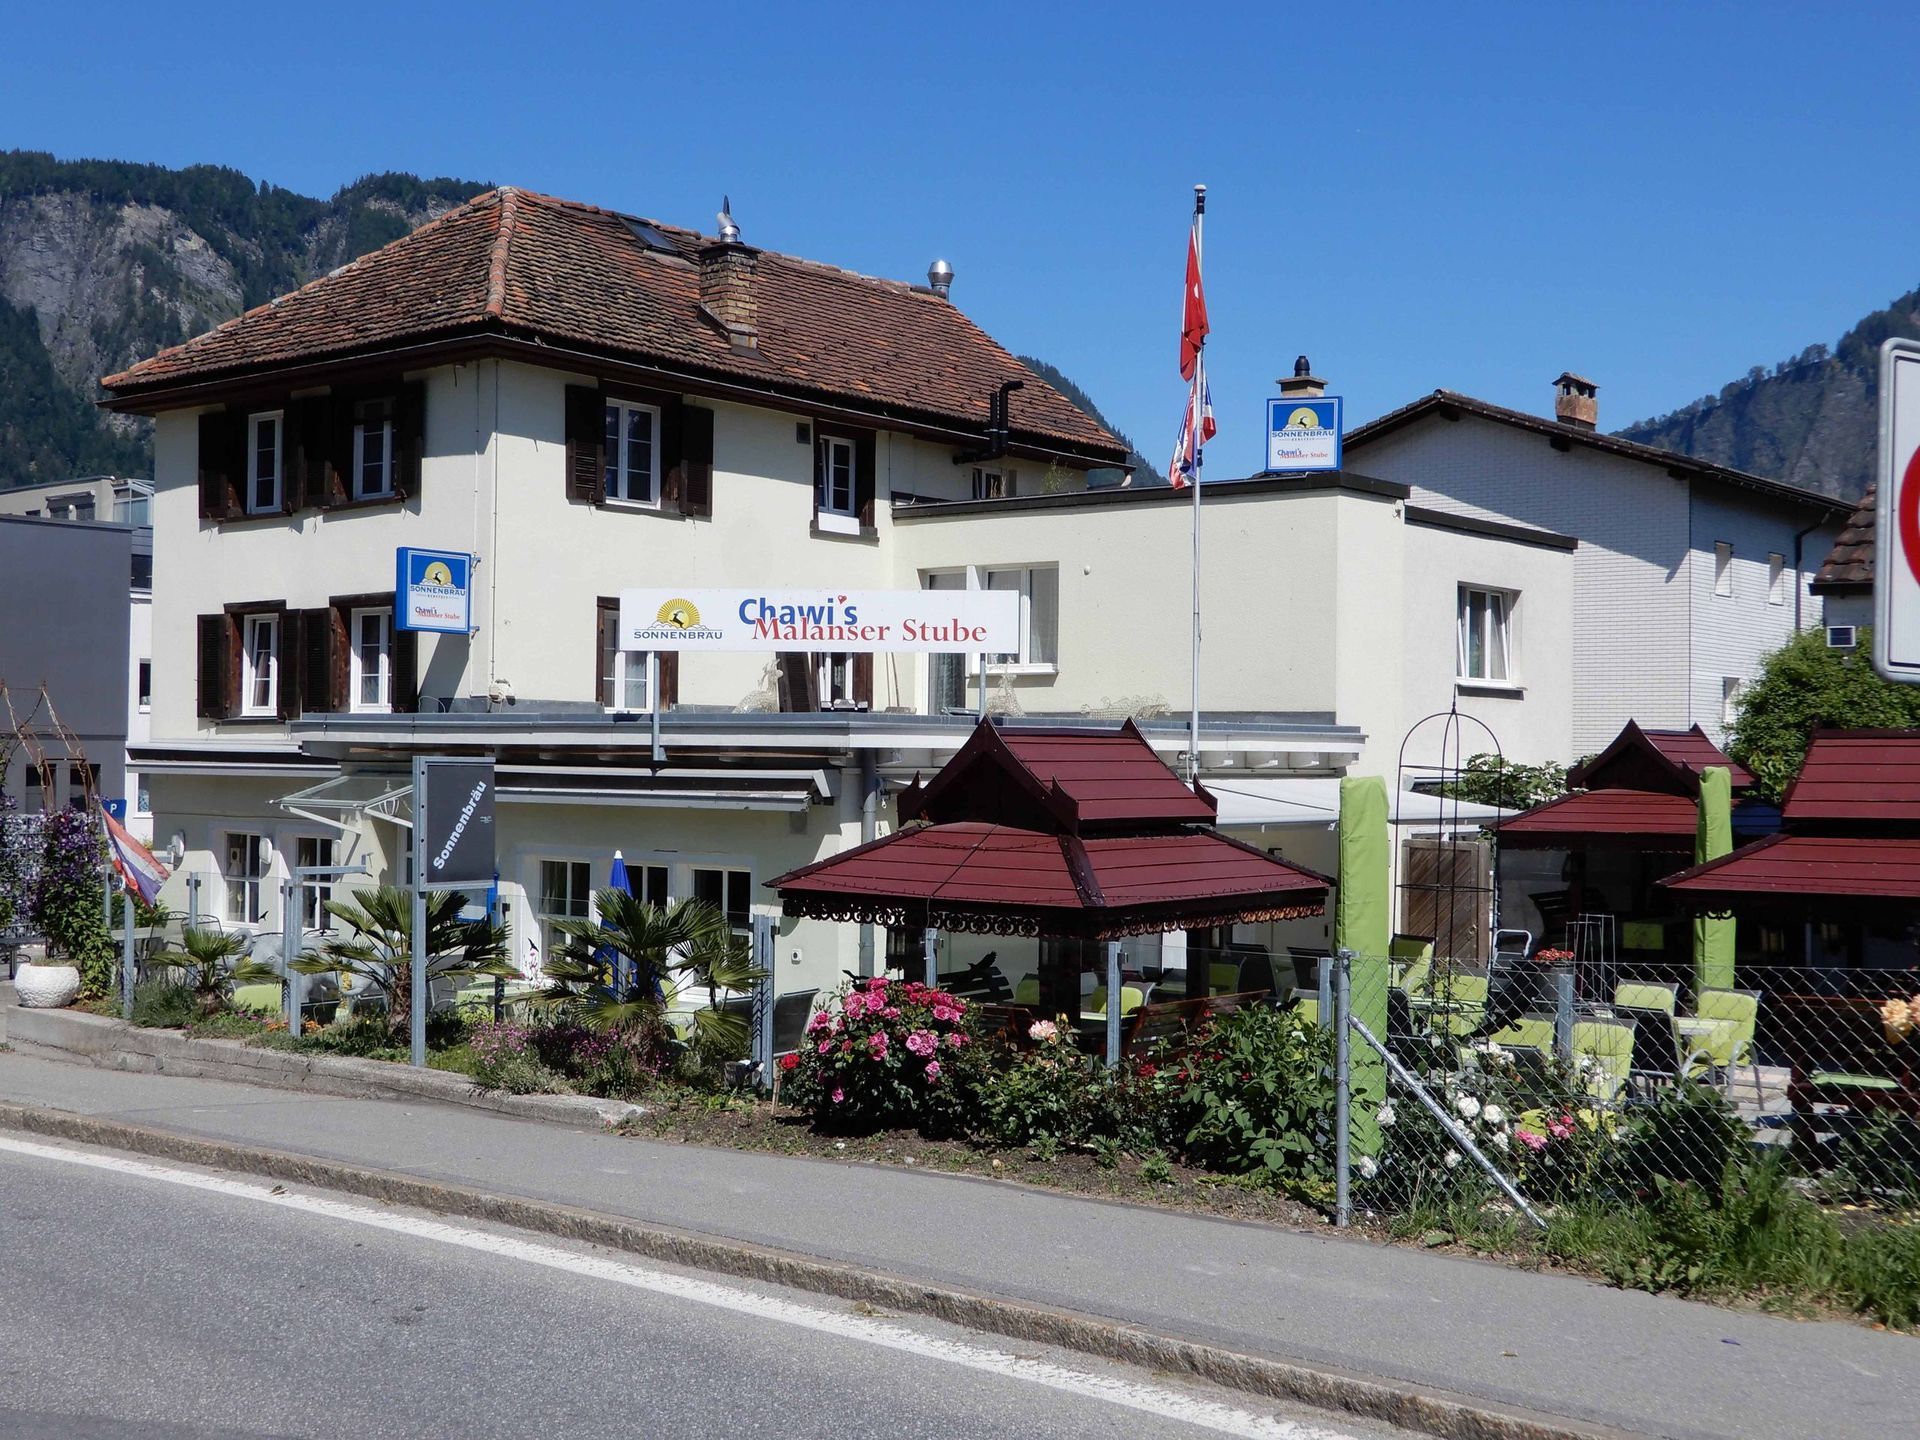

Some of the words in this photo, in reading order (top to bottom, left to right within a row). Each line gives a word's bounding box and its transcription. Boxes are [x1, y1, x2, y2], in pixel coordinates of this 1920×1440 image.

[1272, 430, 1334, 438] SONNENBRÄU
[410, 585, 466, 596] SONNENBRÄU
[738, 595, 858, 625] Chawi's
[633, 630, 723, 640] SONNENBRÄU
[752, 617, 891, 642] Malanser
[902, 618, 987, 643] Stube
[110, 803, 118, 814] P
[433, 781, 487, 869] Sonnenbräu
